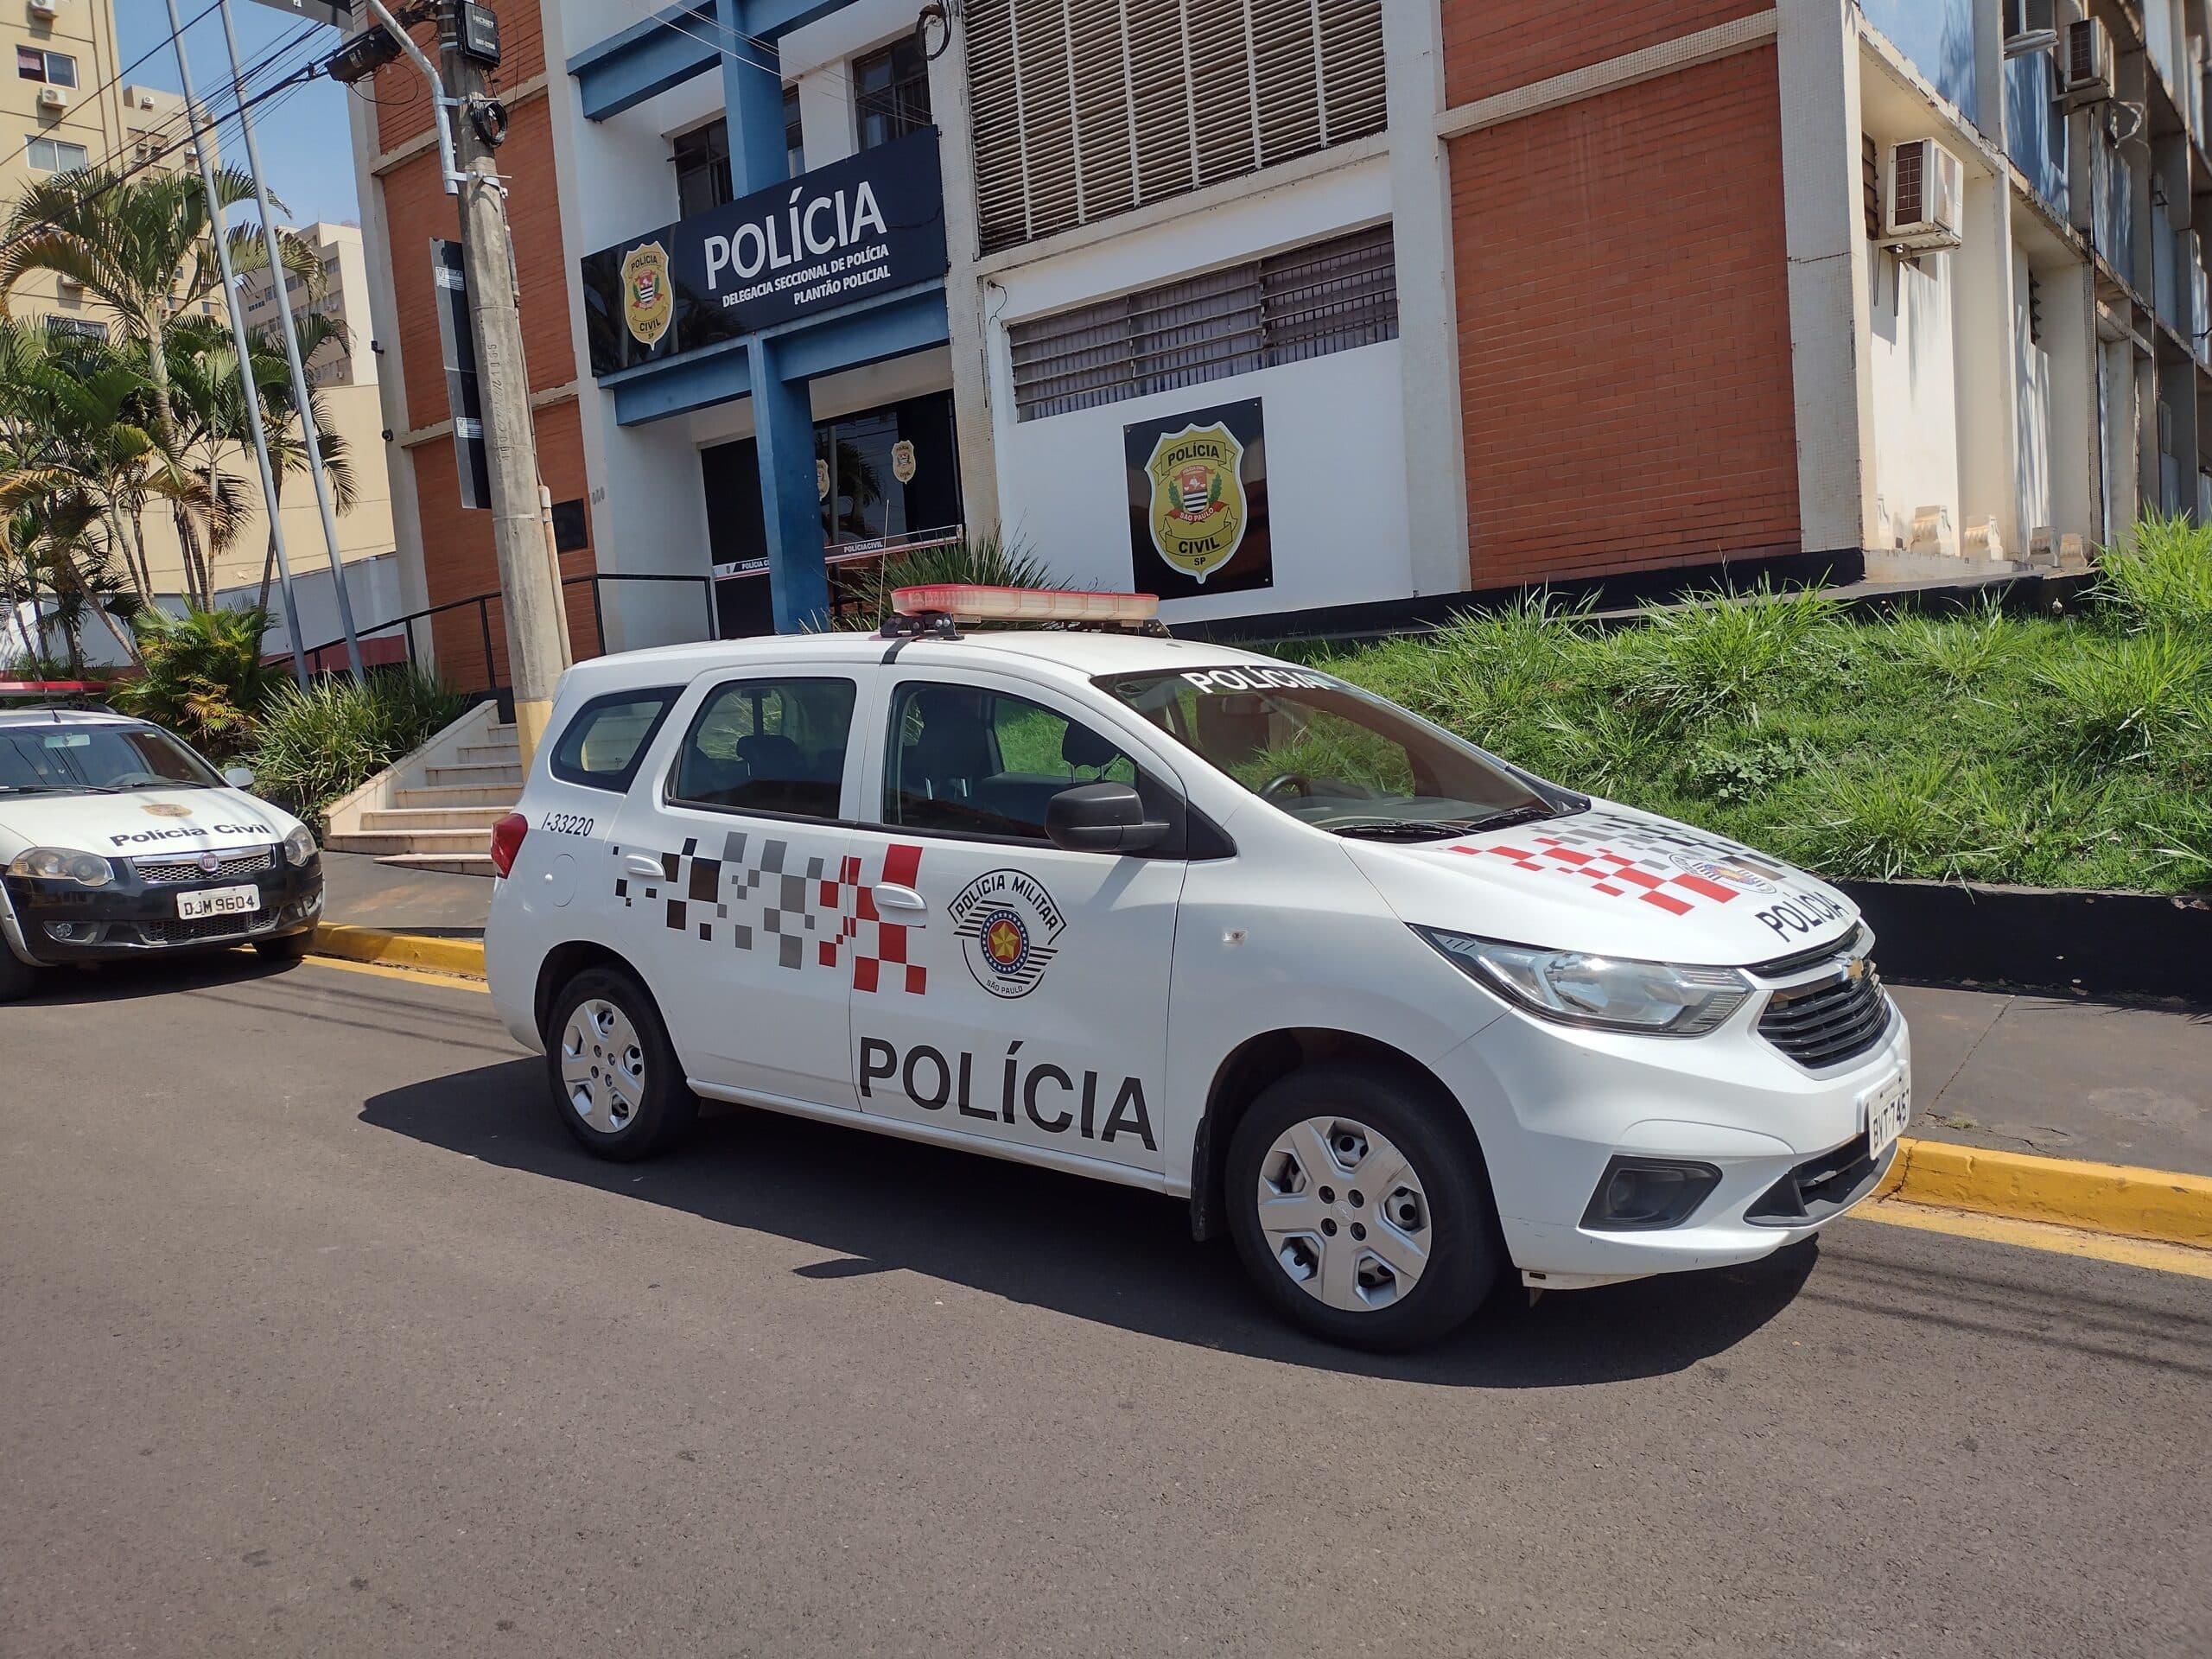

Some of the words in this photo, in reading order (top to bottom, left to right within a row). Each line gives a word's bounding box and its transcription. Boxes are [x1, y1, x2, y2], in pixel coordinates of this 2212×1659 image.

[704, 181, 887, 289] POLÍCIA
[722, 282, 774, 308] DELEGACIA
[774, 263, 830, 291] SECCIONAL
[830, 257, 846, 273] DE
[847, 244, 890, 269] POLÍCIA
[793, 280, 842, 306] PLANTÃO
[843, 265, 892, 291] POLICIAL
[639, 318, 661, 332] CIVIL
[1167, 442, 1220, 467] POLÍCIA
[1193, 507, 1214, 522] PAULO
[867, 541, 883, 550] CIVIL
[1179, 537, 1220, 554] CIVIL
[1193, 557, 1206, 566] SP
[1180, 665, 1332, 693] POLÍCIA
[213, 824, 271, 835] Civil
[541, 812, 594, 836] I-33220
[216, 895, 255, 911] 9604
[955, 874, 1006, 918] POLÍCIA
[1012, 876, 1058, 931] MILITAR
[1754, 891, 1850, 943] POLÍCIA
[1001, 986, 1023, 995] PAULO
[859, 1036, 1158, 1152] POLÍCIA
